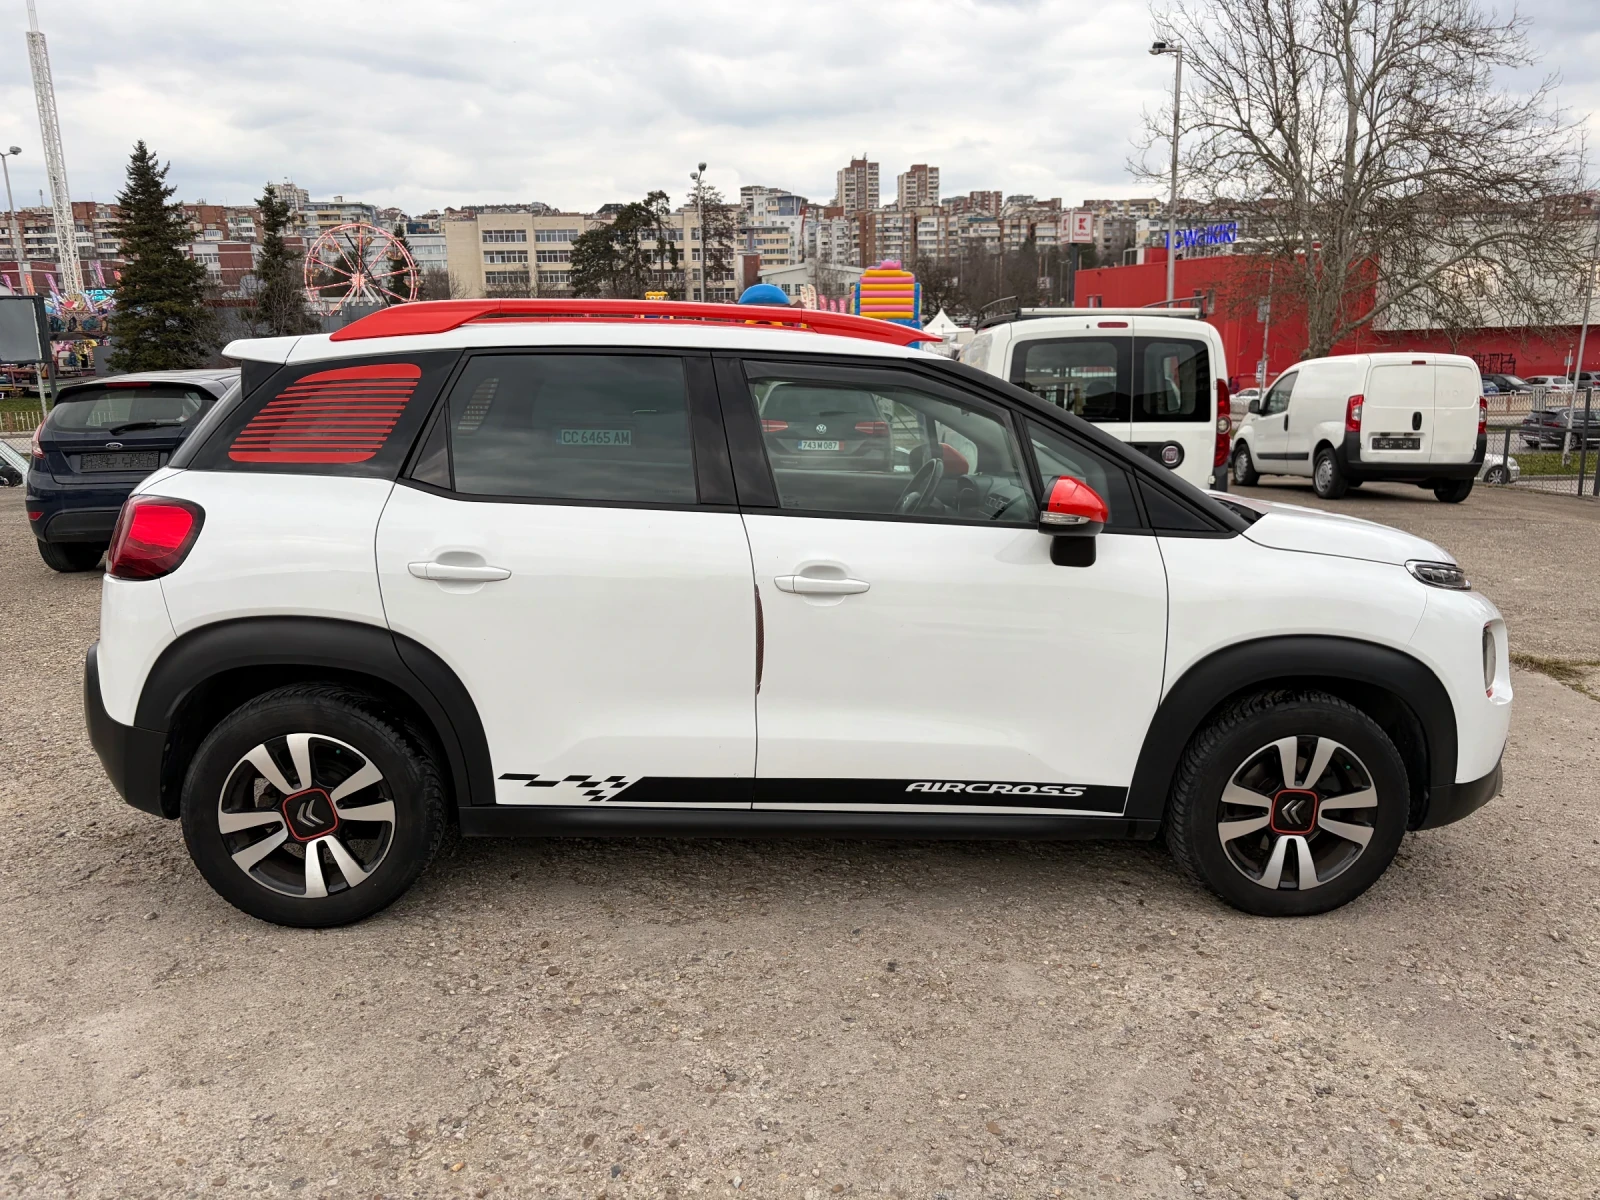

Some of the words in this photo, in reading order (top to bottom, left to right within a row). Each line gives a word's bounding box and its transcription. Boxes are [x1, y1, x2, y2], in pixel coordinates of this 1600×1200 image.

[1078, 217, 1087, 230] K
[563, 431, 579, 444] CC
[581, 431, 611, 444] 6465
[613, 432, 630, 445] AM
[905, 781, 1088, 798] AIRCROSS
